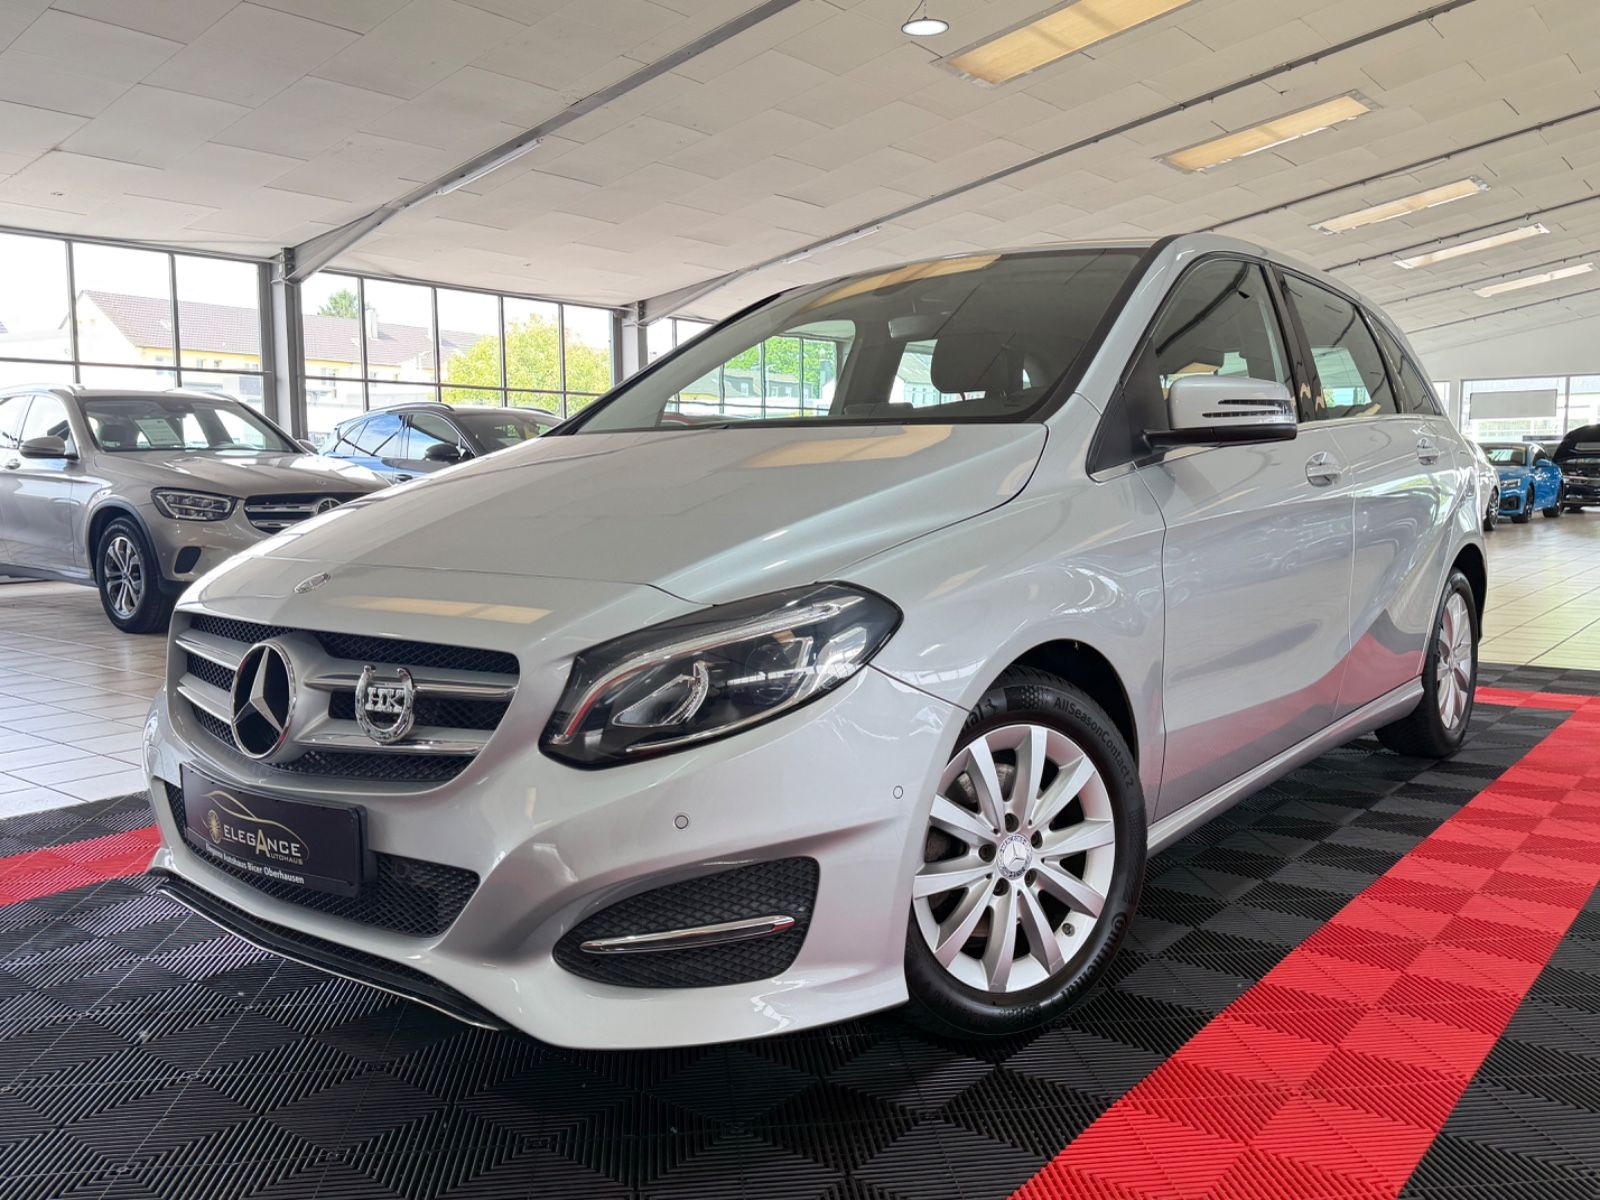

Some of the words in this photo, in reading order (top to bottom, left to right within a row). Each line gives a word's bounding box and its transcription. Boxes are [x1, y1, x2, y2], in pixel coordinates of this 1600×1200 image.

[1053, 697, 1130, 778] AllSeasonContact
[223, 824, 301, 857] ELEGANCE
[264, 866, 304, 884] Oberhausen
